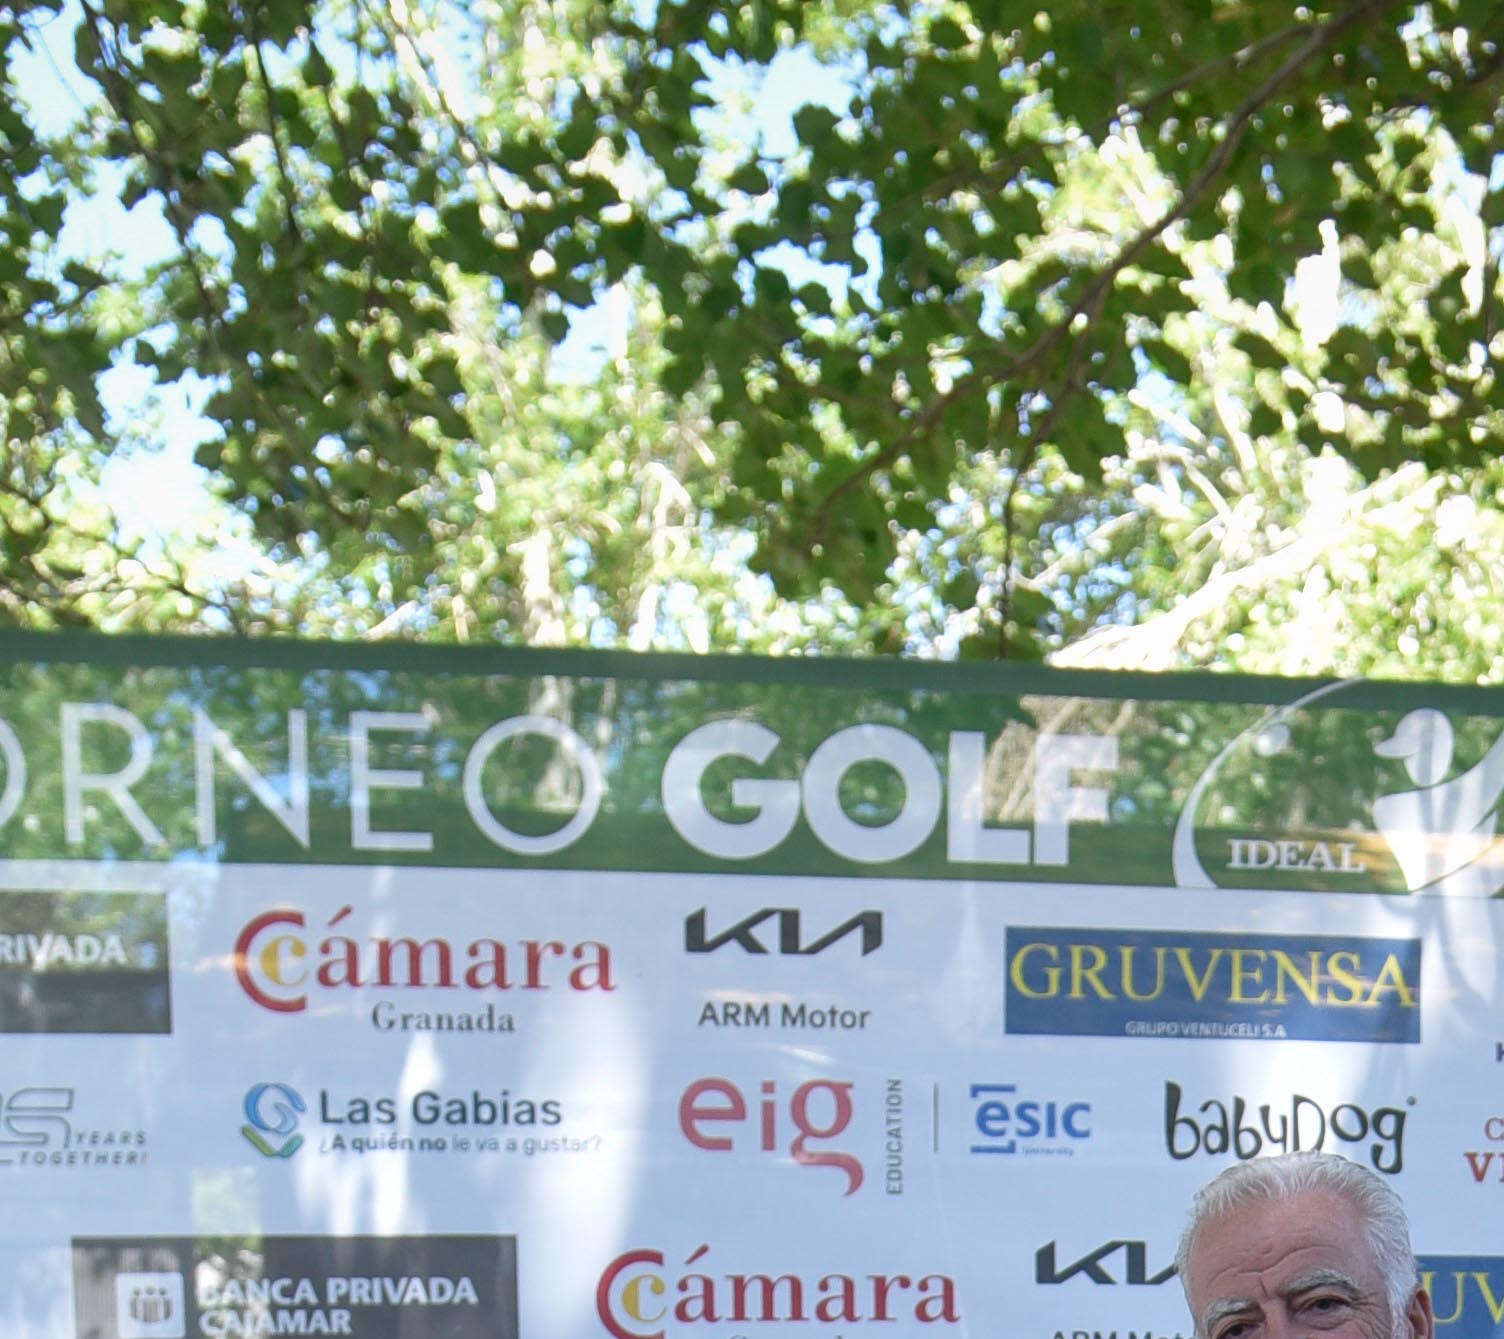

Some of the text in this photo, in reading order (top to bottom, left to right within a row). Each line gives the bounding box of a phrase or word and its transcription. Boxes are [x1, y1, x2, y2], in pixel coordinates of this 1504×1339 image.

[661, 718, 1120, 866] GOLF
[1226, 839, 1367, 874] IDEAL
[684, 907, 884, 957] KIA
[234, 904, 618, 1013] Cámara
[1009, 942, 1420, 1010] GRUVENSA
[371, 1002, 516, 1034] Granada
[697, 1003, 872, 1030] ARM Motor
[1125, 1020, 1178, 1038] GRUPO
[319, 1090, 564, 1126] Las Gabias
[76, 1129, 148, 1146] YEARS
[351, 1131, 414, 1156] quién
[418, 1138, 448, 1153] no
[452, 1134, 471, 1152] le
[475, 1138, 502, 1152] va
[522, 1134, 602, 1157] gustar?
[679, 1076, 866, 1198] eig
[885, 1078, 904, 1196] EDUCATION
[20, 1149, 149, 1167] TOGETHER!
[199, 1275, 479, 1306] BANCA PRIVADA
[199, 1308, 353, 1339] CAJAMAR
